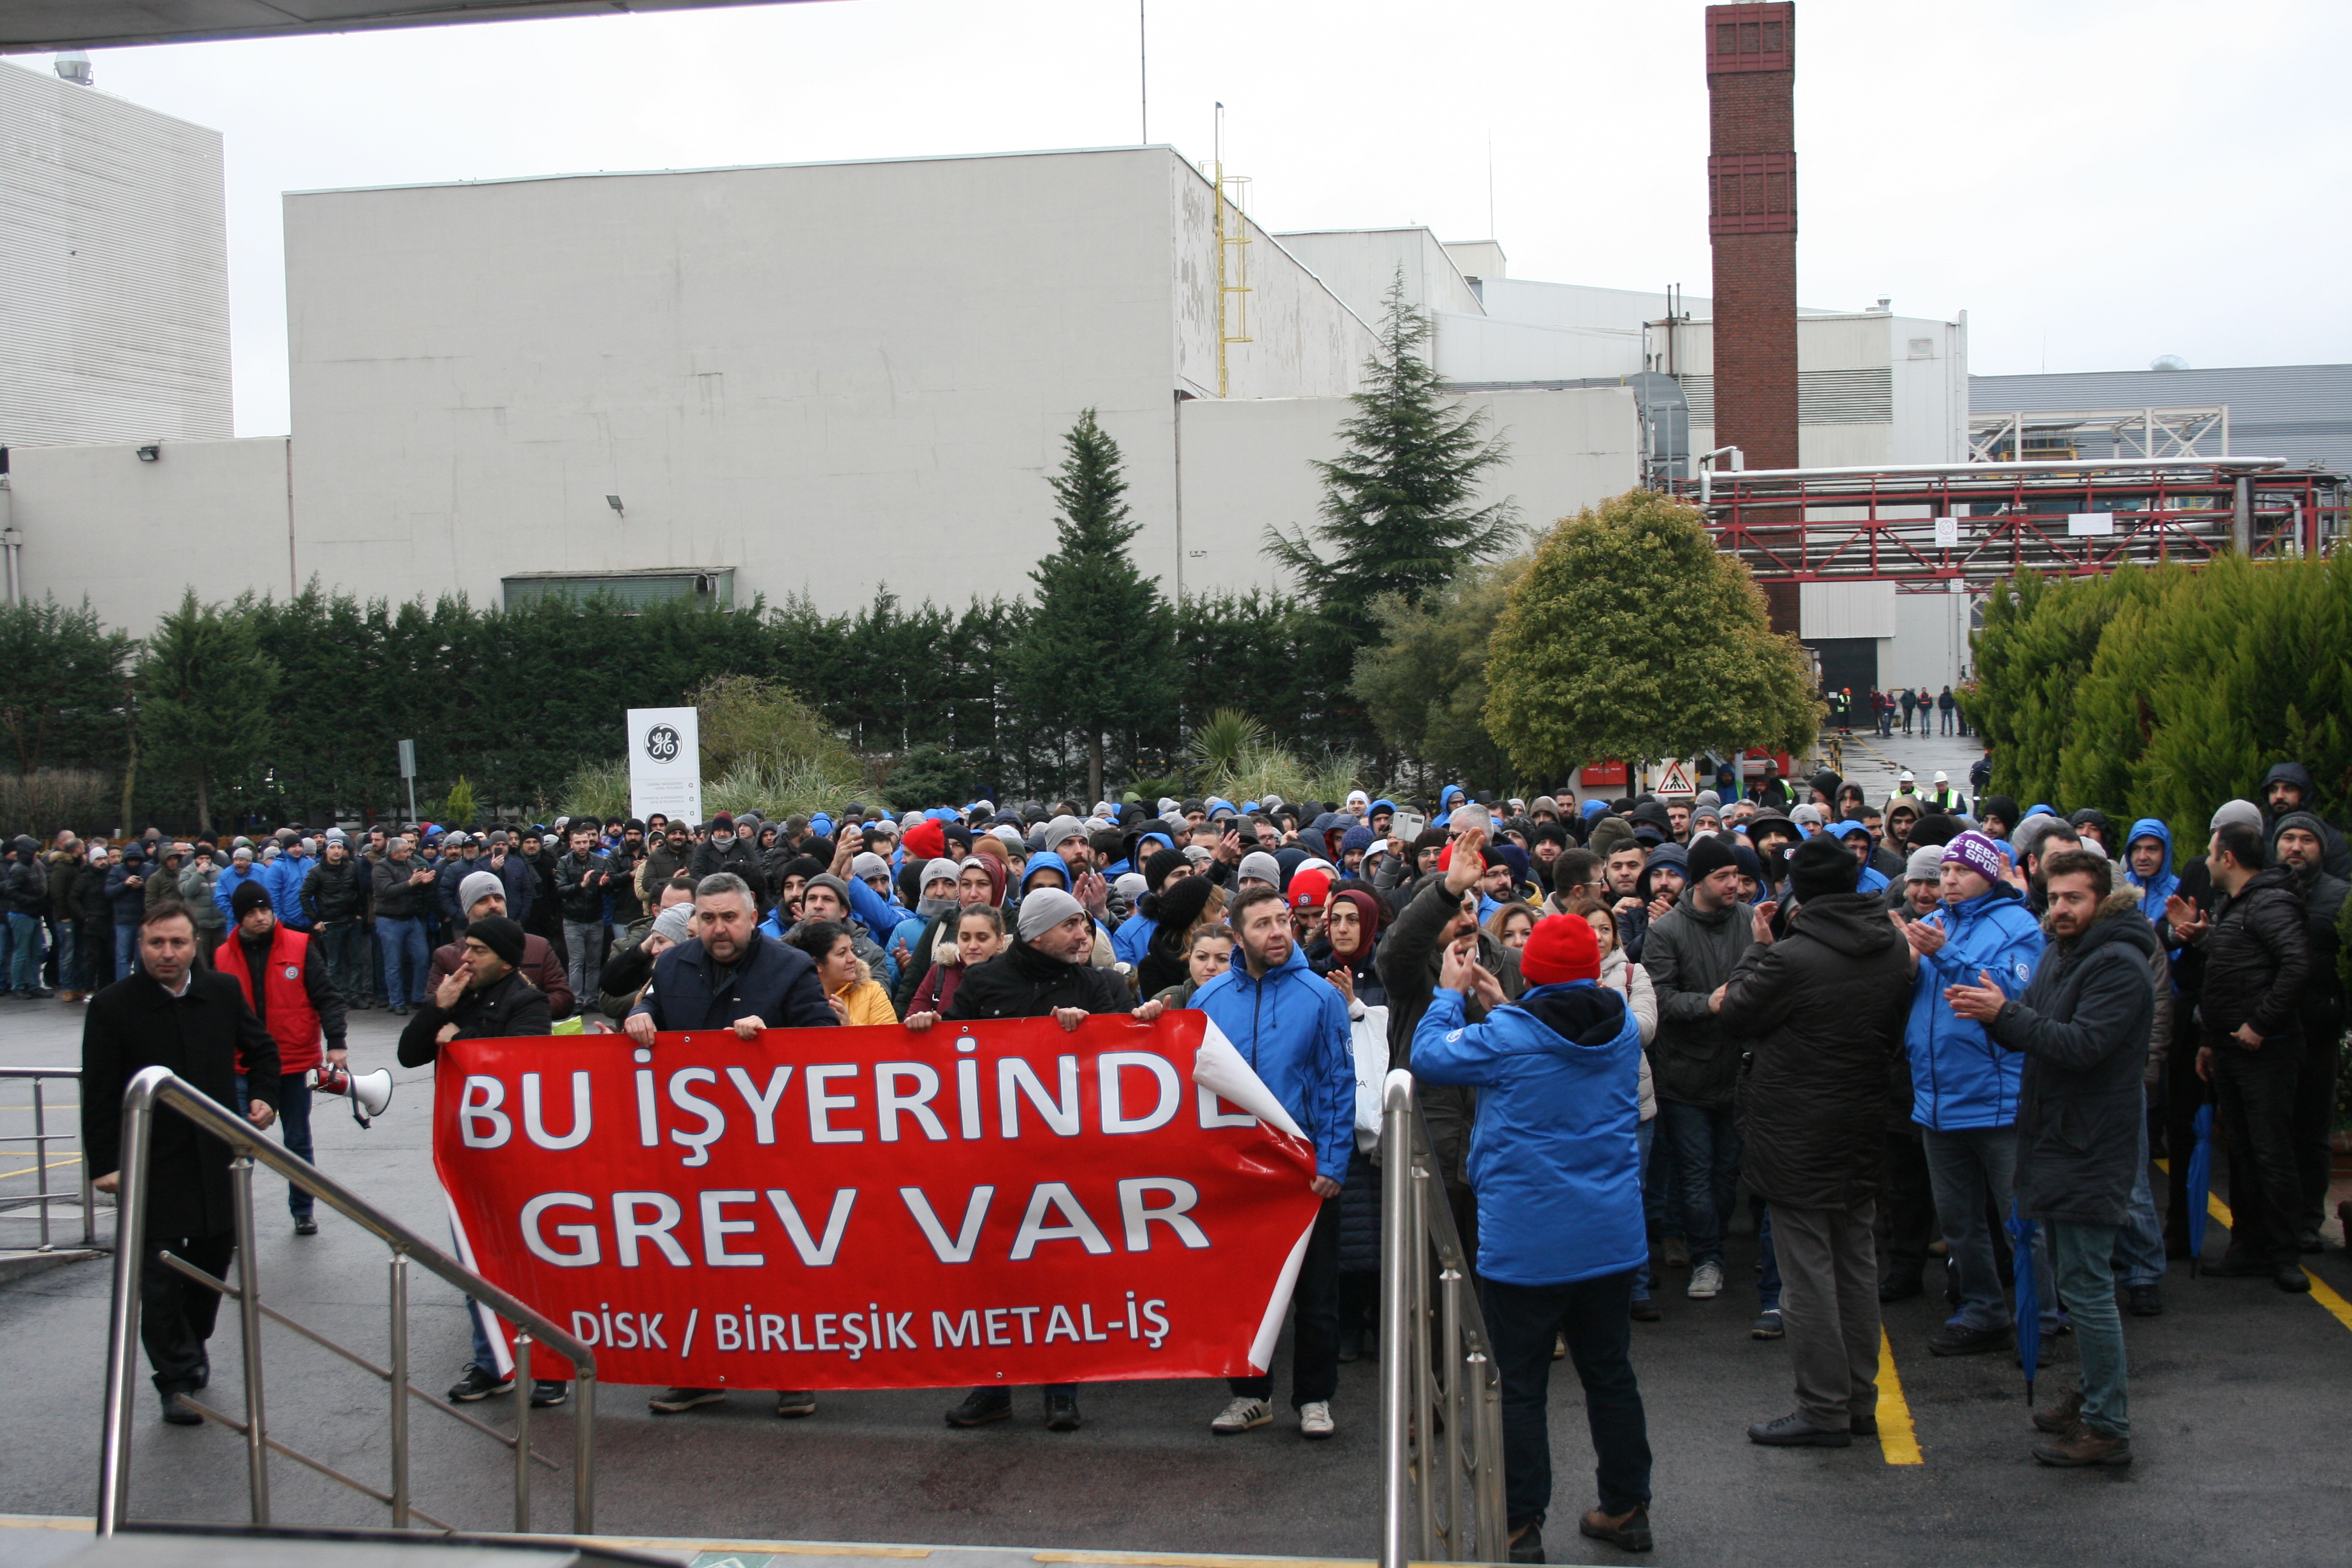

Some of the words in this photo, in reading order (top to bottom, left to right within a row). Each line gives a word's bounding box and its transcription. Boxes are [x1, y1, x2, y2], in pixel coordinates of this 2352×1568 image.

[1965, 849, 1998, 877] SPOR
[459, 1070, 593, 1151] BU
[520, 1187, 858, 1268] GREV
[898, 1176, 1211, 1264] VAR
[571, 1302, 669, 1349] DİSK
[681, 1308, 699, 1357] /
[714, 1303, 918, 1361] BİRLEŞİK
[931, 1290, 1171, 1350] METAL-İŞ
